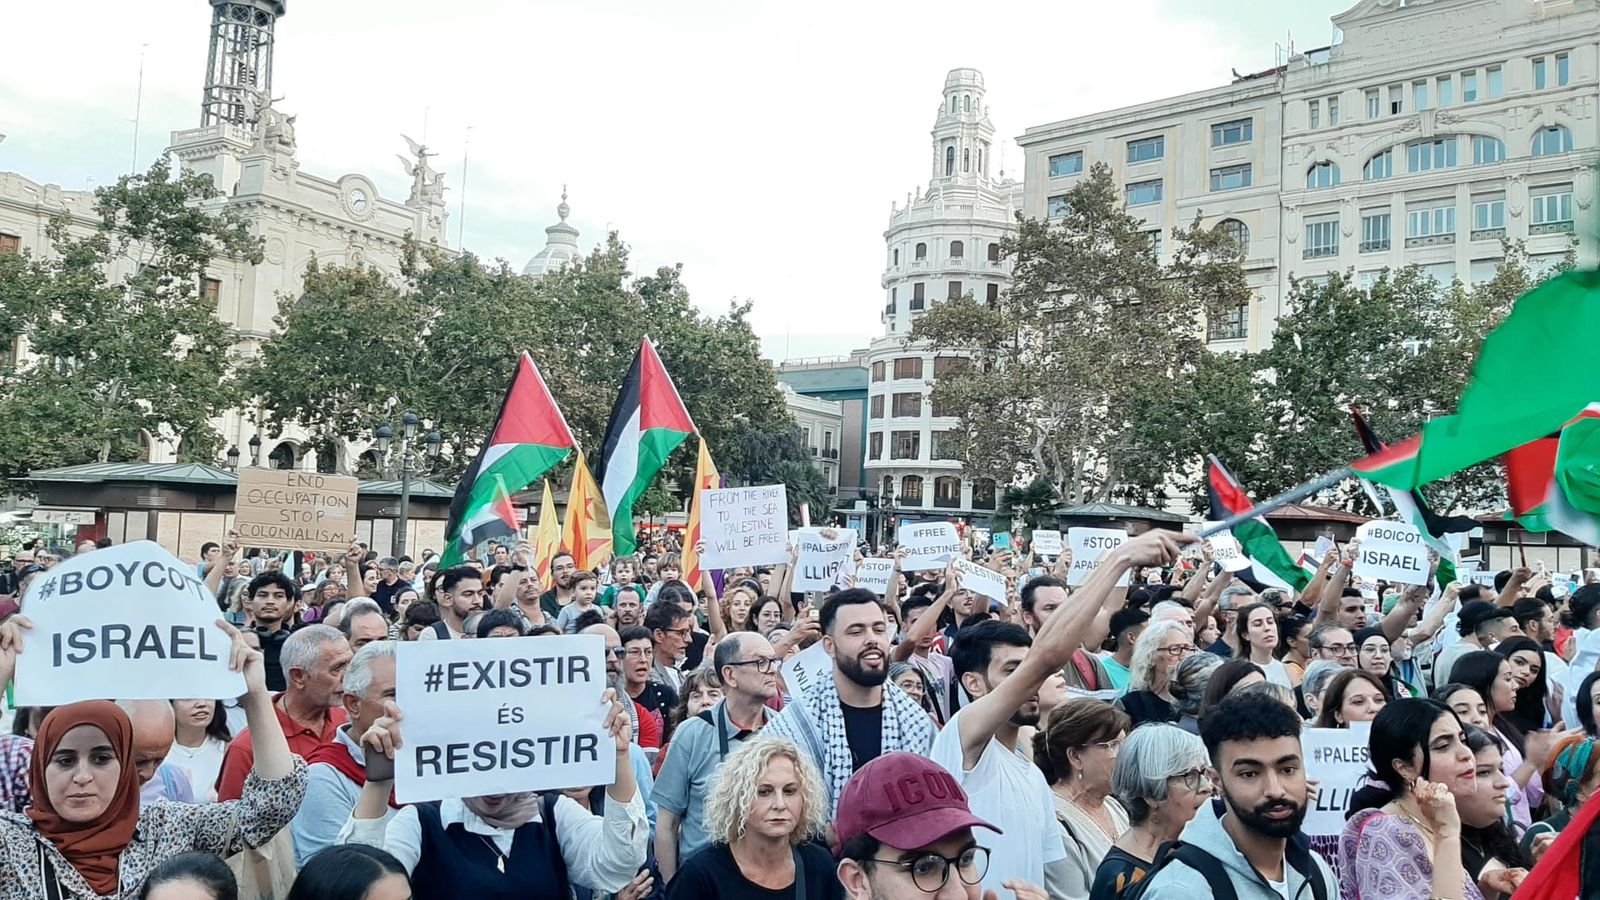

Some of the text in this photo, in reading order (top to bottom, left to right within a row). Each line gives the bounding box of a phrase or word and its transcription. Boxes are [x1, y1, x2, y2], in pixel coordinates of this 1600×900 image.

[287, 472, 325, 488] END
[247, 488, 349, 508] OCCUPATION
[709, 487, 779, 508] FROM THE RIVER
[280, 509, 325, 523] STOP
[717, 503, 778, 522] TO THE SEA
[240, 523, 344, 543] COLONIALISM
[724, 518, 774, 536] PALESTINE
[913, 527, 947, 538] #FREE
[1367, 528, 1421, 544] #BOICOT
[715, 532, 780, 553] WILL BE FREE
[905, 544, 959, 556] PALESTINE
[1083, 536, 1121, 550] #STOP
[1074, 560, 1103, 570] APAR
[1363, 550, 1421, 571] ISRAEL
[38, 561, 206, 601] #BOYCOTT
[958, 561, 1004, 584] PALESTINE
[52, 623, 218, 667] ISRAEL
[424, 655, 591, 692] #EXISTIR
[497, 703, 525, 724] ÉS
[415, 733, 599, 777] RESISTIR
[1315, 788, 1355, 811] LLI
